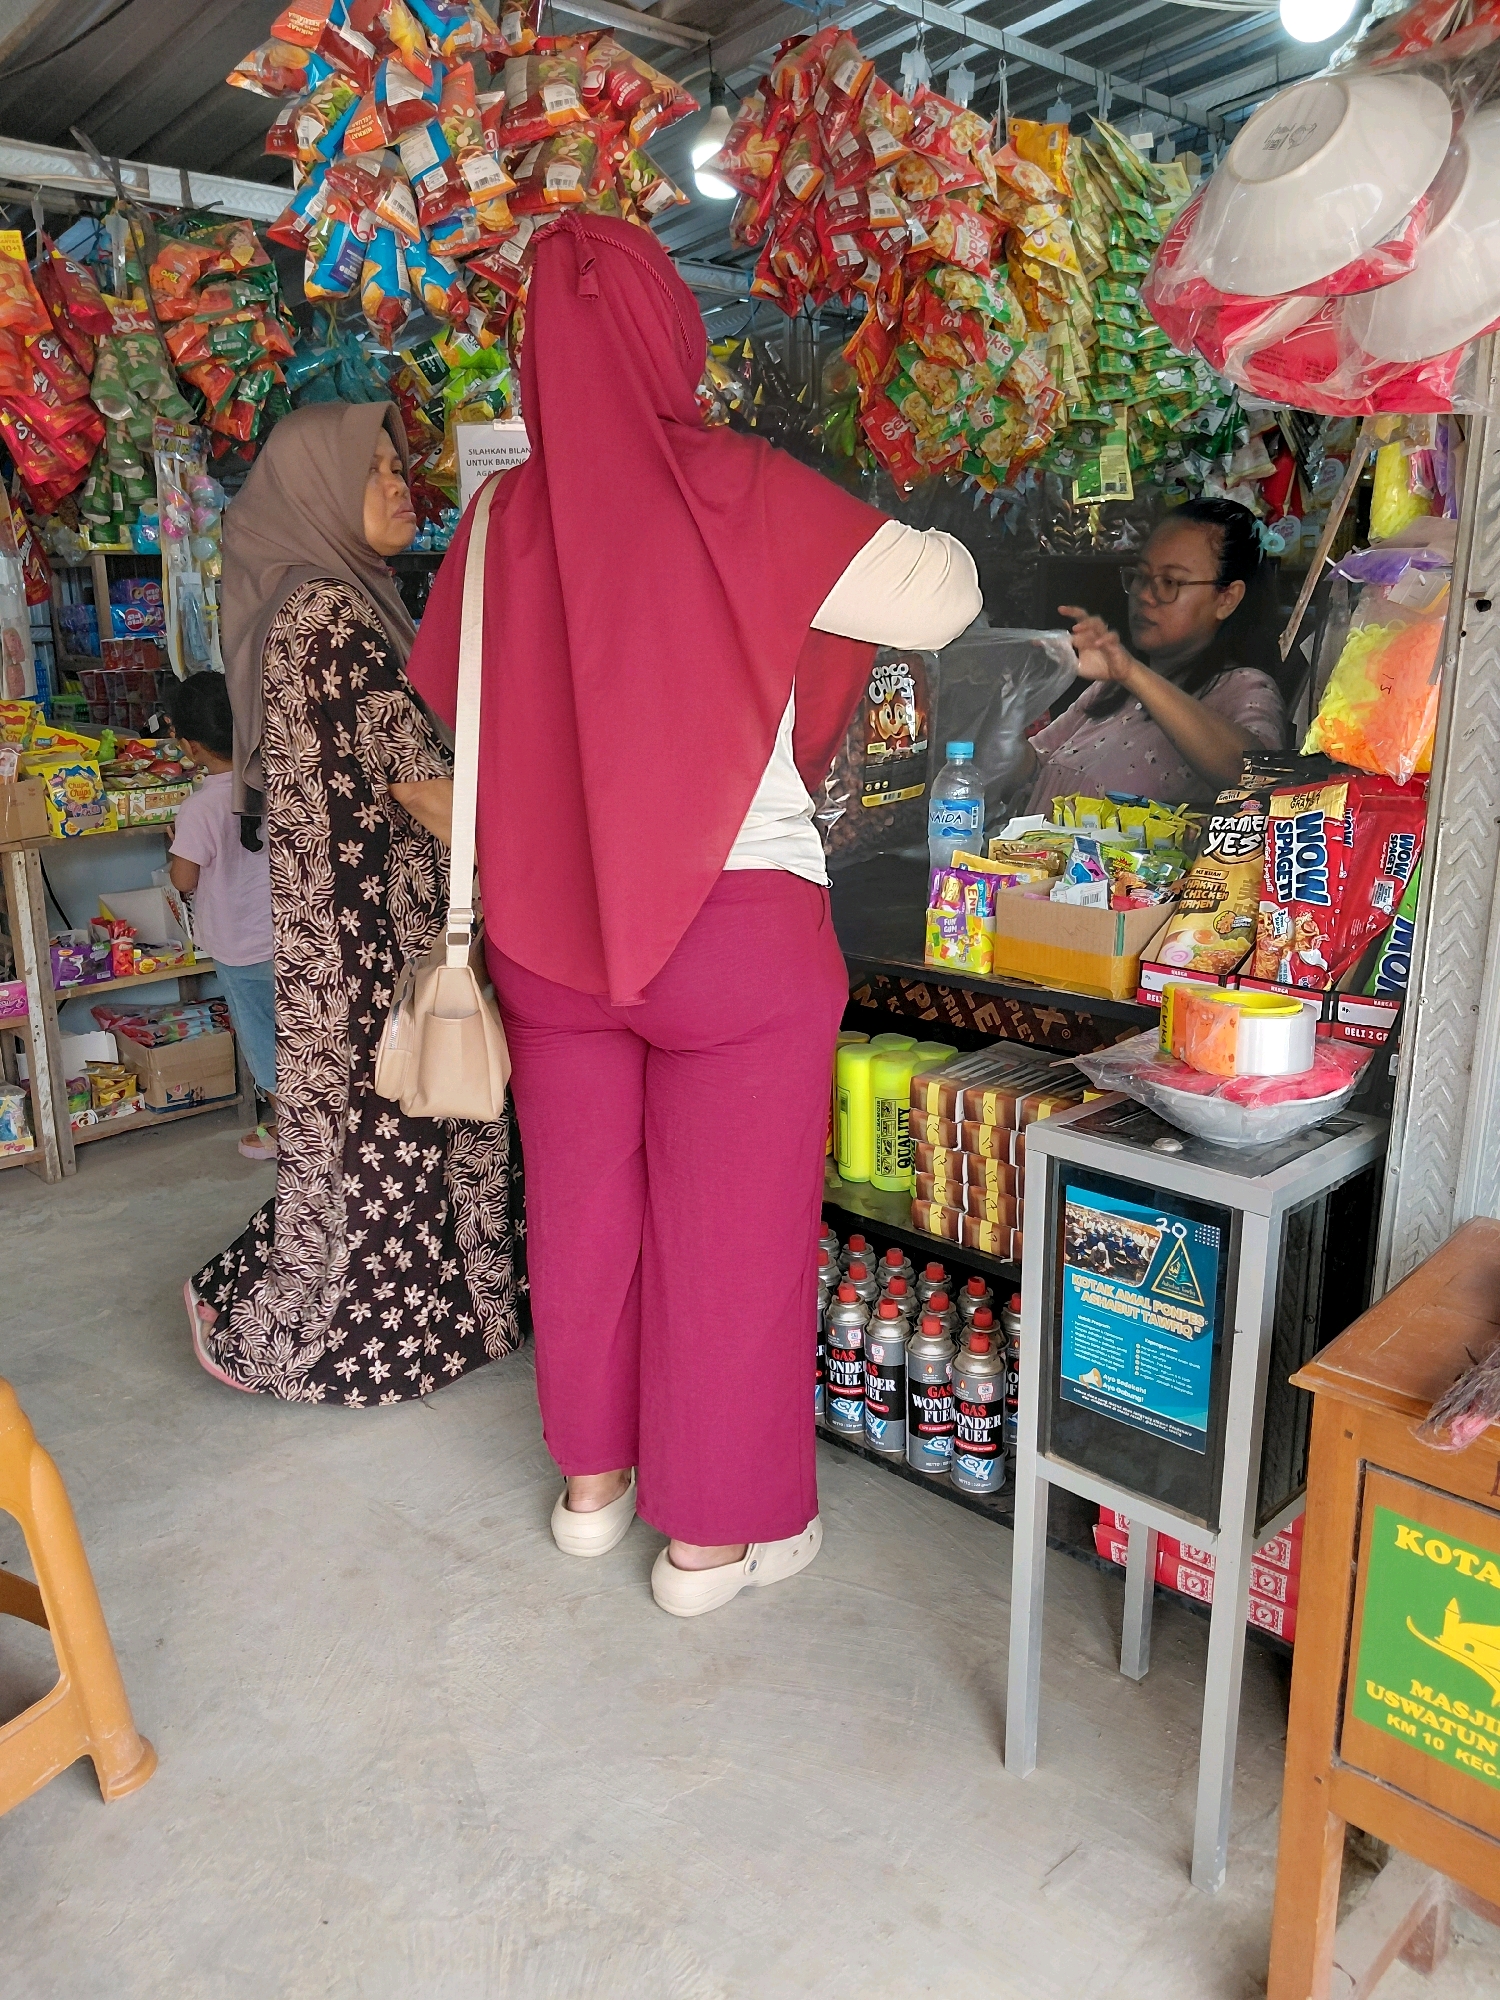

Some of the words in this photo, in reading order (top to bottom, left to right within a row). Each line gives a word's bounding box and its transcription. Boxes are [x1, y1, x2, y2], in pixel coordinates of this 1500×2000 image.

[872, 663, 909, 679] CHOCO
[70, 788, 92, 798] Chups
[1276, 822, 1294, 901] SPAGETI
[1296, 811, 1330, 905] WOW
[1384, 834, 1398, 875] SPAGETI
[1391, 834, 1416, 881] WOW
[1187, 880, 1227, 891] HAKATA
[1183, 890, 1230, 900] CHICKEN
[1179, 899, 1214, 909] RAMEN
[944, 918, 957, 926] FUN
[944, 925, 958, 933] GUM
[1368, 1031, 1374, 1039] 2
[897, 1108, 911, 1169] QUALITY
[1155, 1217, 1188, 1239] 20
[1071, 1273, 1116, 1297] KOTAK
[1116, 1288, 1151, 1311] AMAL
[1152, 1299, 1205, 1328] PONPES
[832, 1349, 856, 1361] GAS
[830, 1370, 861, 1386] FUEL
[1103, 1373, 1116, 1384] Ayo
[1103, 1382, 1115, 1393] Ayo
[960, 1402, 987, 1417] GAS
[958, 1425, 991, 1443] FUEL
[1394, 1524, 1500, 1589] KOTA
[1366, 1680, 1498, 1757] USWATUN
[1386, 1713, 1417, 1738] KM
[1422, 1733, 1445, 1751] 10
[1455, 1748, 1500, 1779] KEC.
